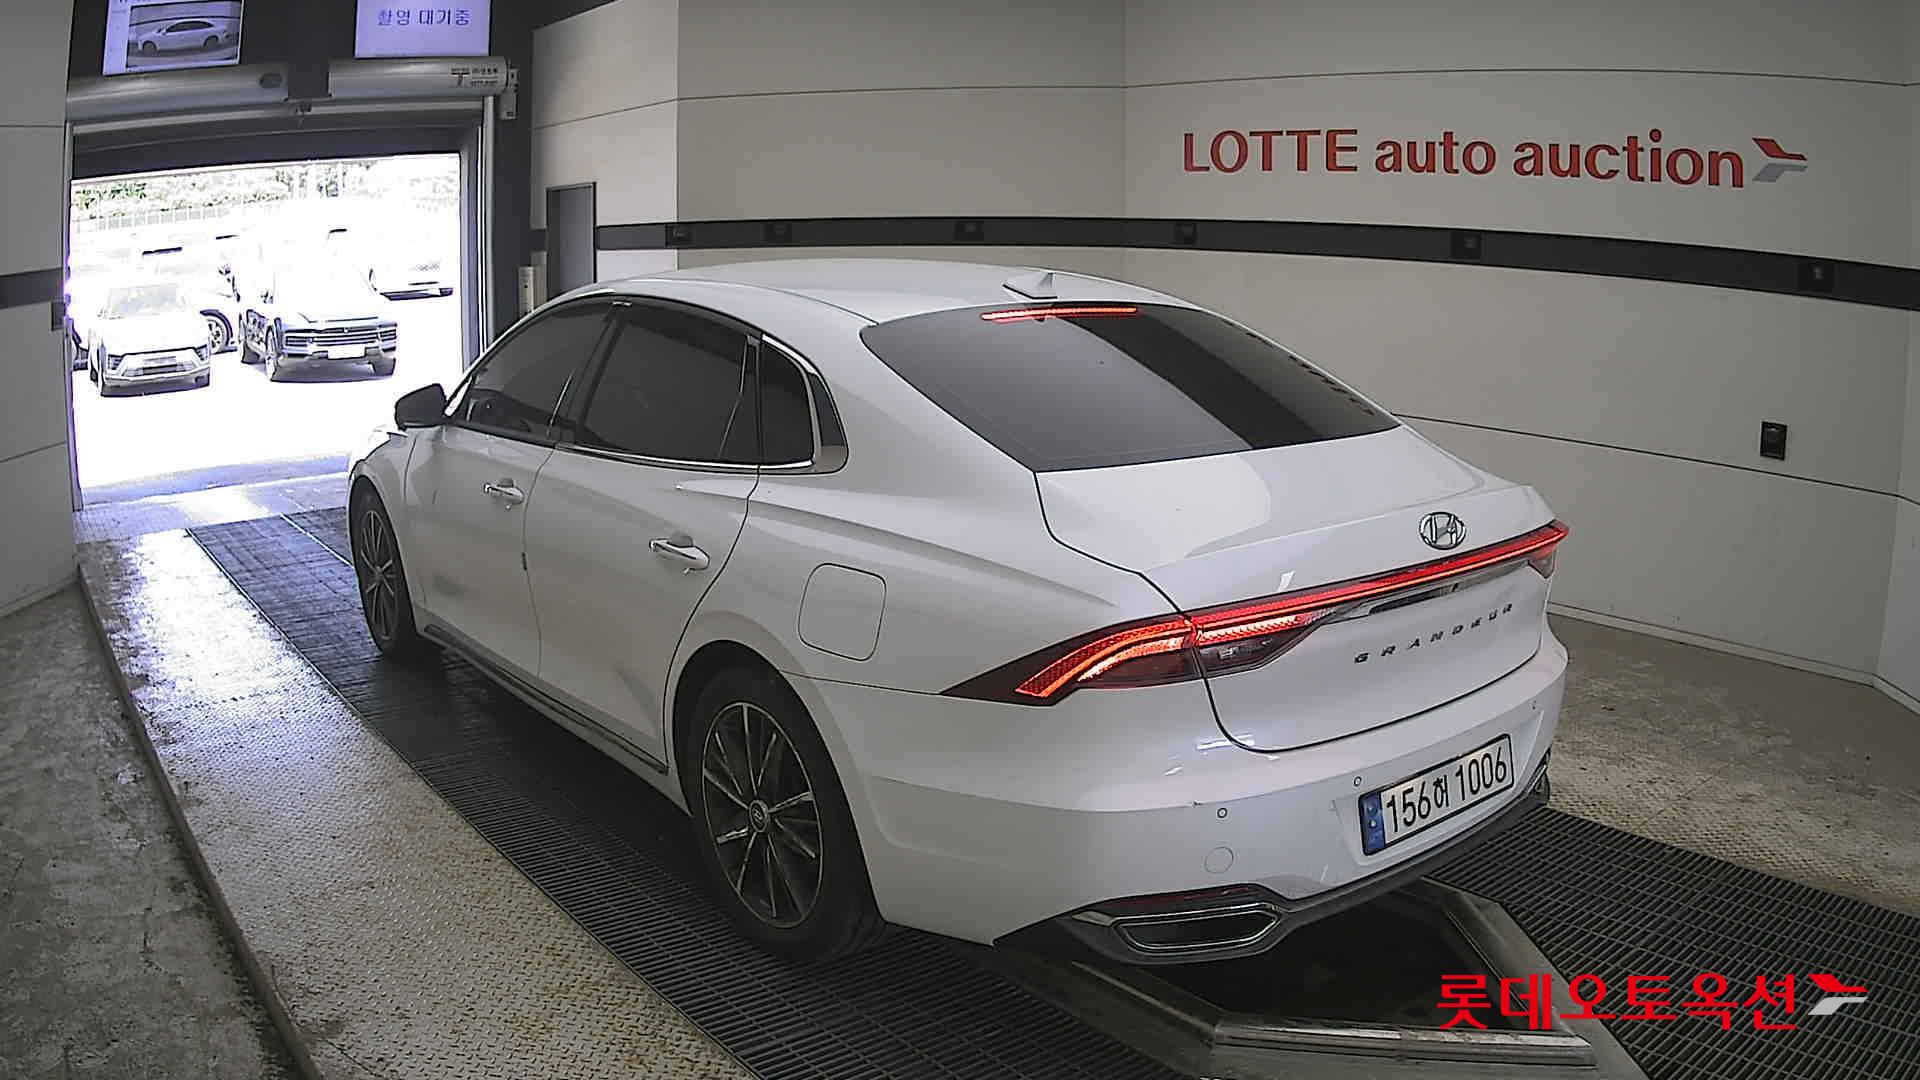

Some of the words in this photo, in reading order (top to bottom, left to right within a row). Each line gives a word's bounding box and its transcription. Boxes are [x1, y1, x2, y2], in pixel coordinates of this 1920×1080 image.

[1183, 129, 1359, 174] LOTTE
[1375, 131, 1498, 175] auto
[1513, 129, 1745, 189] auction
[1354, 603, 1513, 664] GRANDEUR
[1455, 746, 1507, 801] 1006
